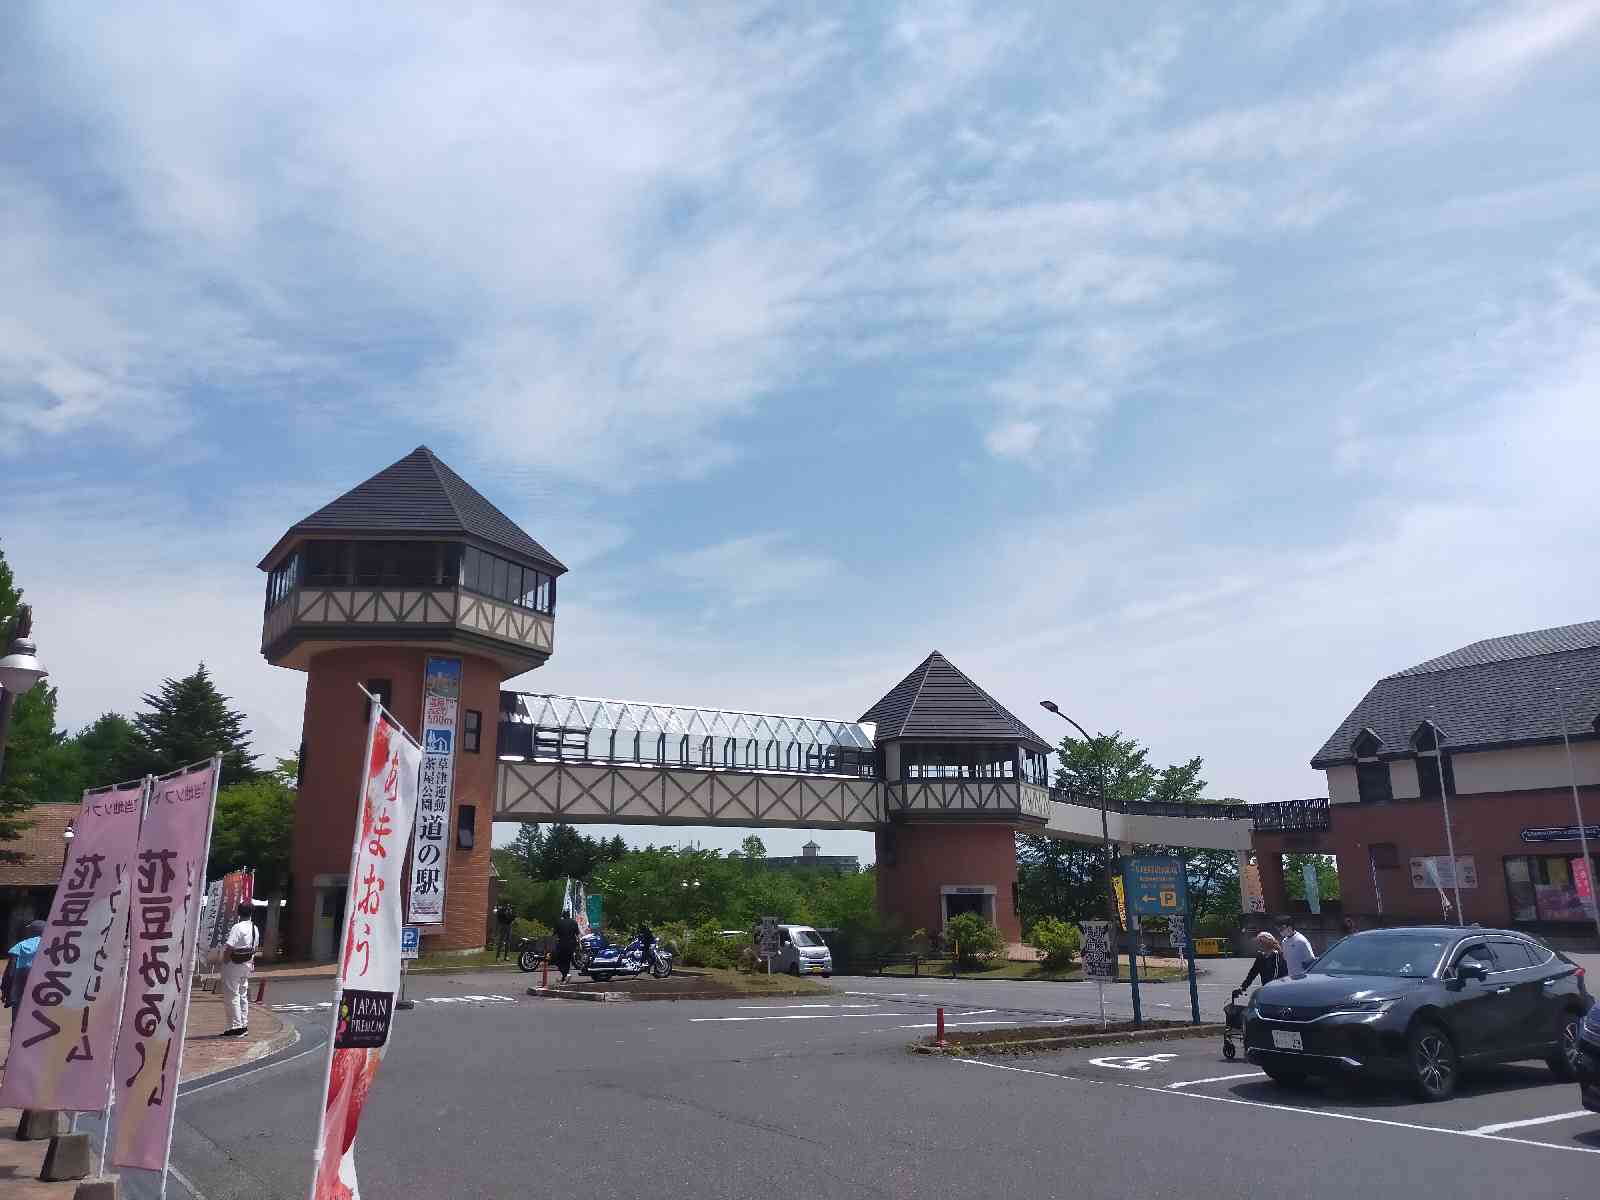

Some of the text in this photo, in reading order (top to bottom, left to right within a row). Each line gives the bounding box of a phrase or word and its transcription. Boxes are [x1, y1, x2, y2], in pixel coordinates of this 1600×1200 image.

[434, 757, 449, 813] 草津運動
[414, 815, 444, 895] 道の駅
[352, 997, 387, 1019] JAPAN
